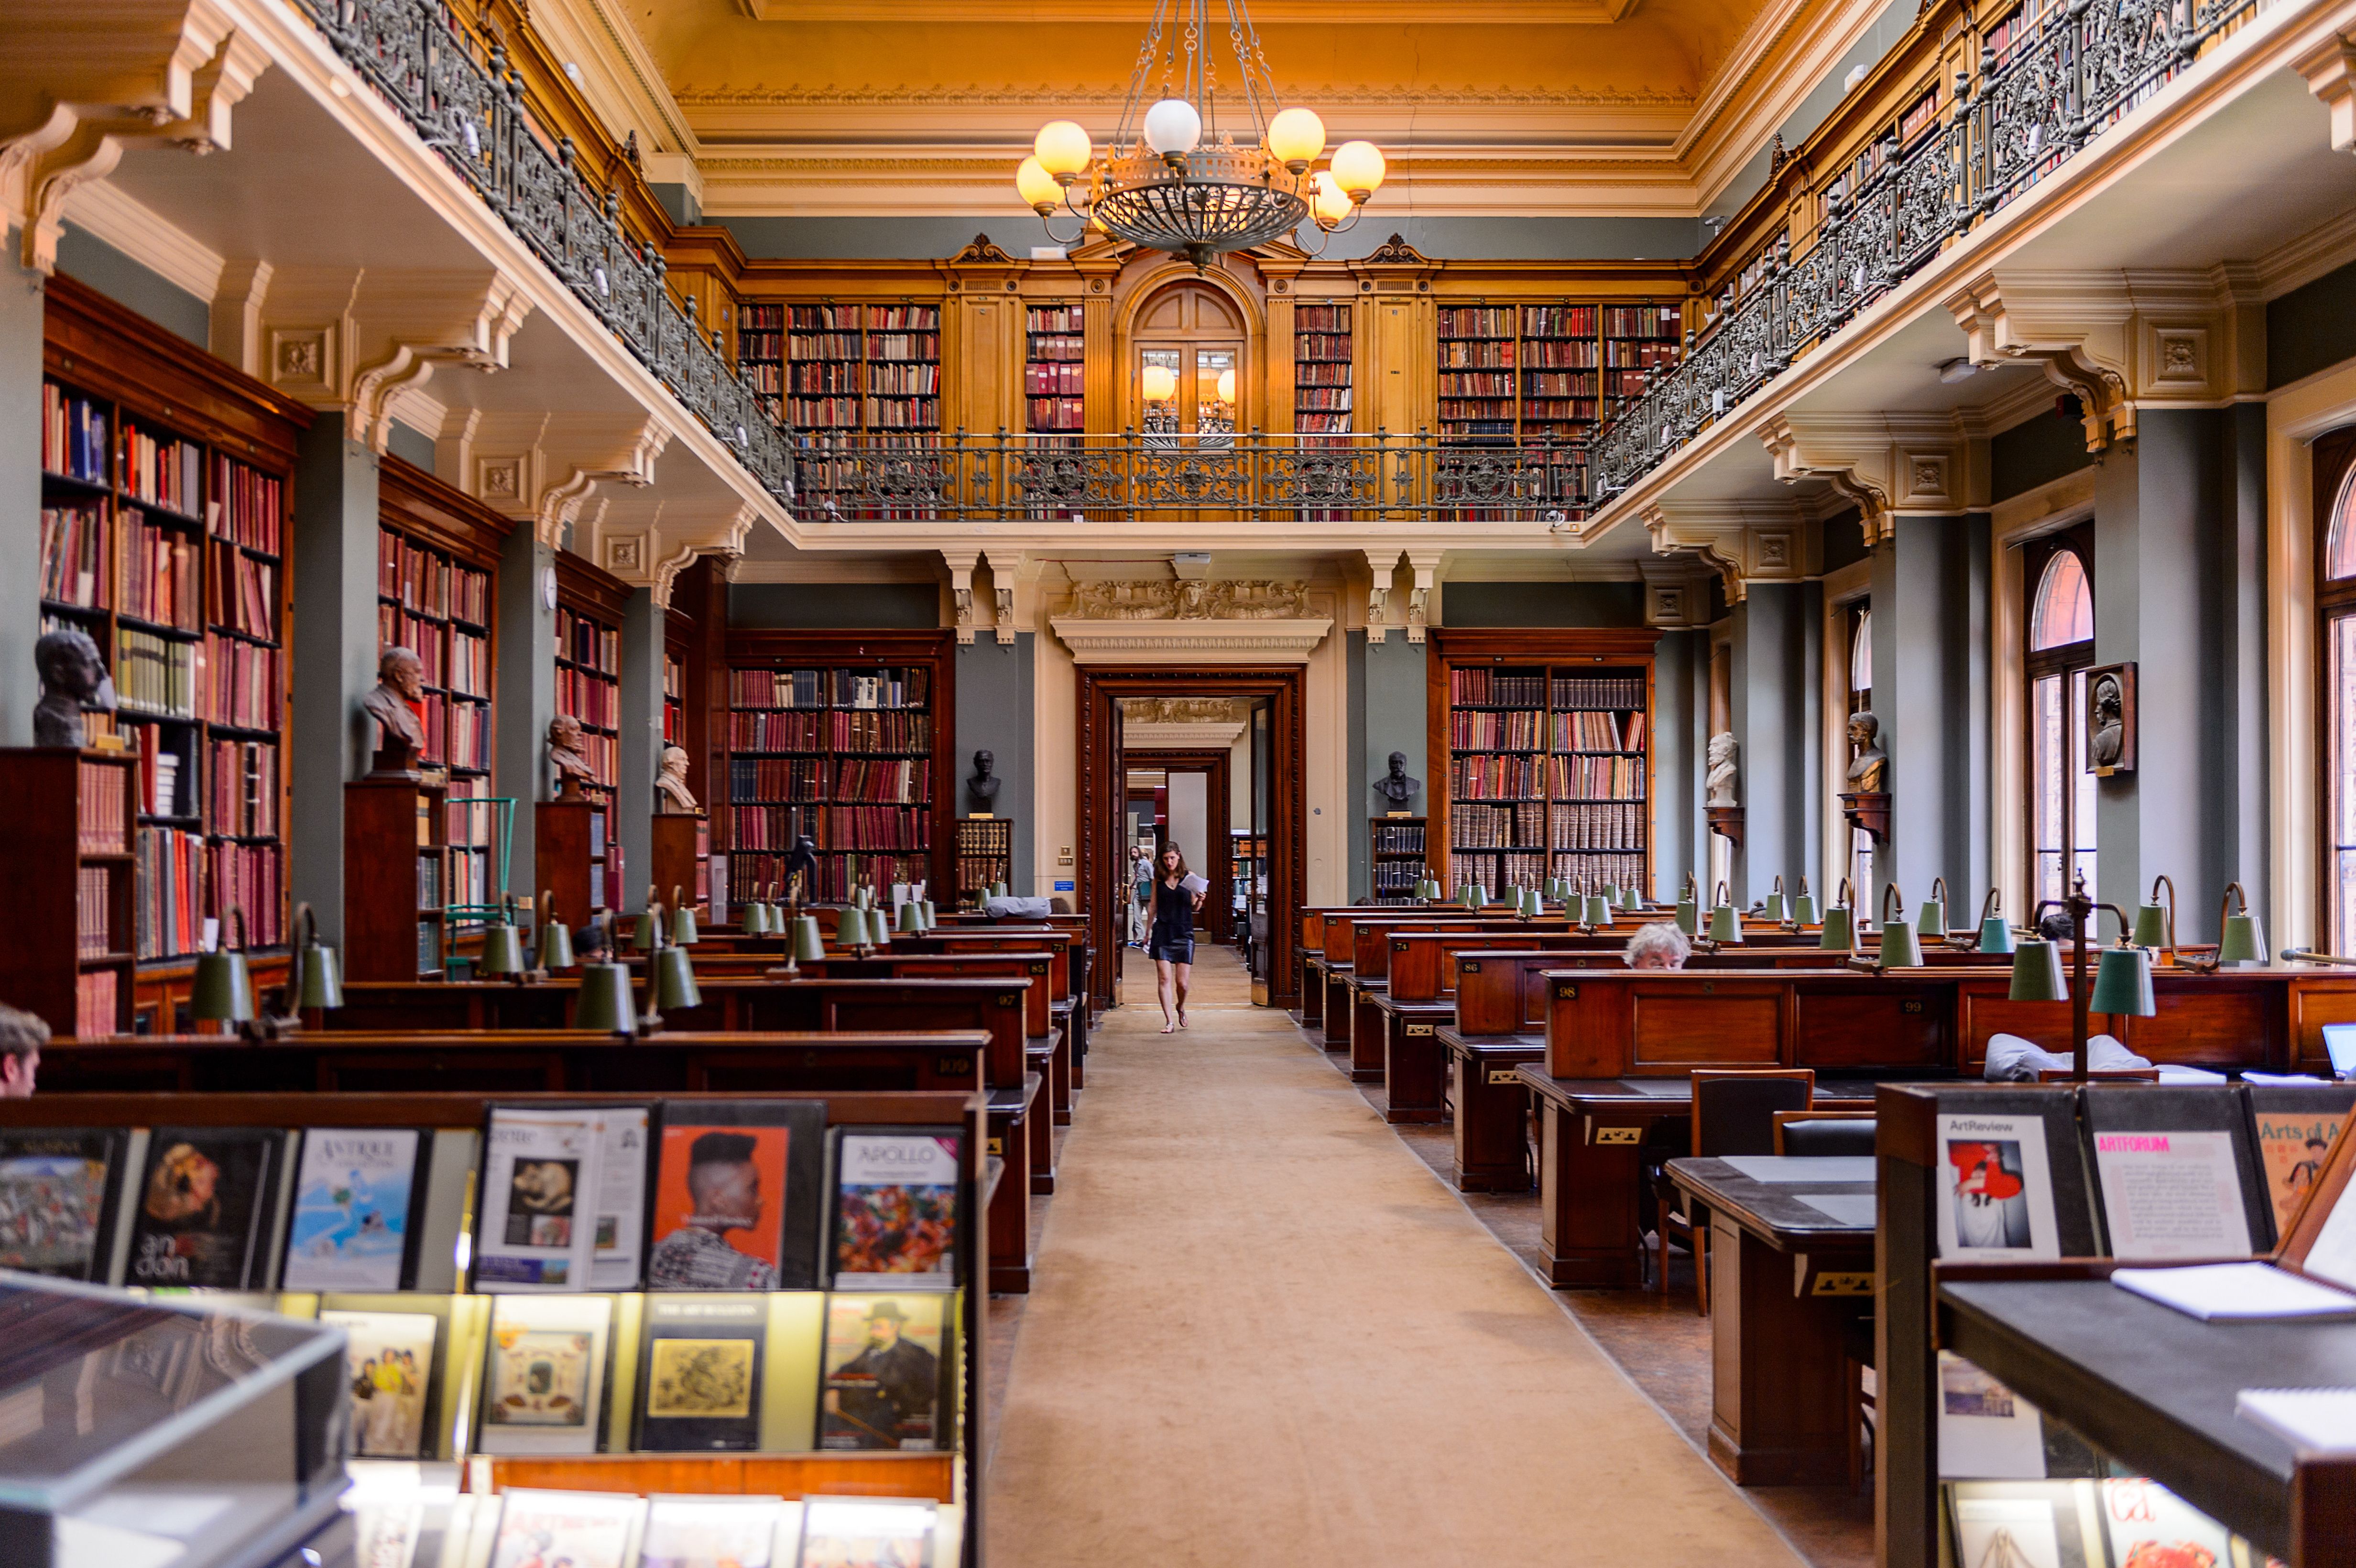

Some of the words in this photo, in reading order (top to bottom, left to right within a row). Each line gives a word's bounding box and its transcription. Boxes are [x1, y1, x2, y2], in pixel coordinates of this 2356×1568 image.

[1031, 965, 1045, 973] 85
[1464, 963, 1478, 971] 86
[1559, 986, 1576, 998] 98
[998, 994, 1016, 1006] 97
[1904, 1002, 1922, 1013] 99
[1950, 1120, 2014, 1132] ArtReview
[2261, 1122, 2303, 1140] Arts
[2098, 1136, 2171, 1153] ARTFORUM
[857, 1146, 937, 1164] APOLLO
